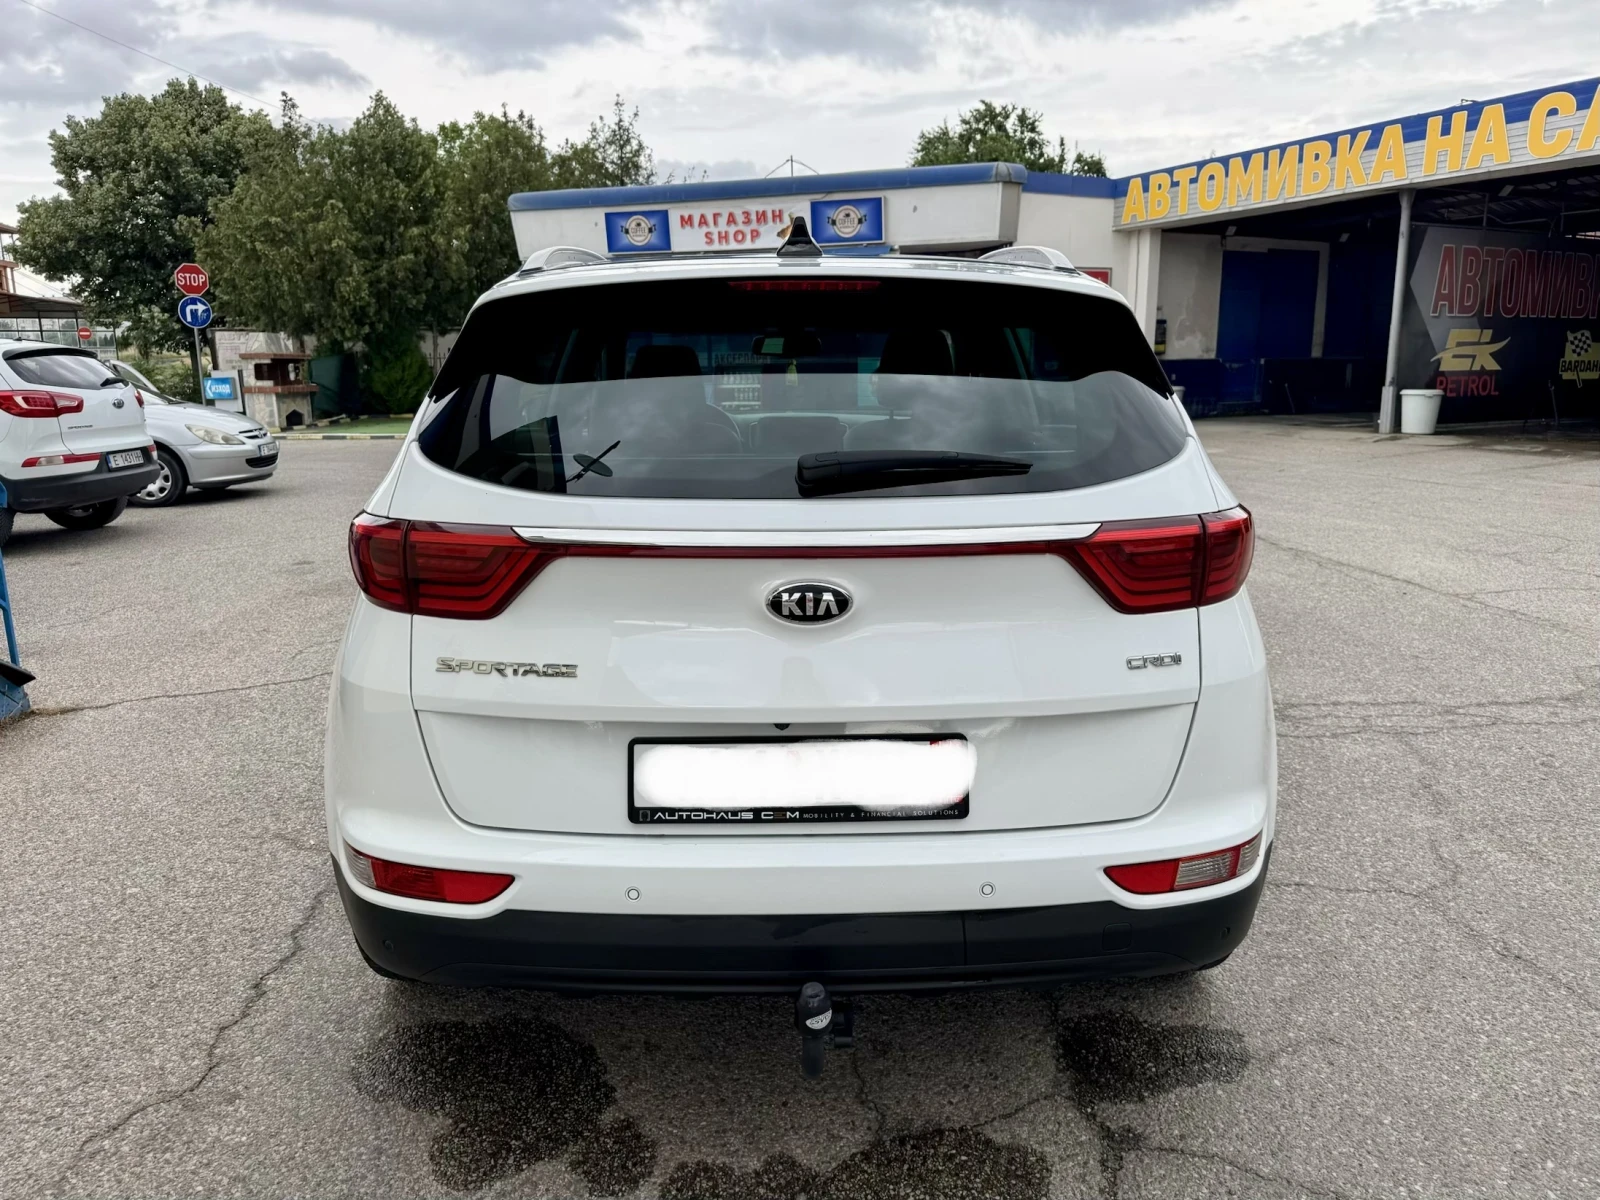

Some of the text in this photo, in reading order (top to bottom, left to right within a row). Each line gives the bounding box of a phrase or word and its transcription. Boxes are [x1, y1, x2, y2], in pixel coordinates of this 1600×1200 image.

[1121, 123, 1408, 225] АВТОМИВКА
[1422, 103, 1511, 177] НА
[679, 208, 783, 229] МАГАЗИН
[704, 228, 761, 247] SHOP
[177, 272, 206, 287] STOP
[1560, 359, 1600, 373] BARDAH
[211, 384, 231, 394] ИЗХОД
[1436, 375, 1500, 398] PETROL
[781, 592, 839, 616] KIA
[435, 656, 579, 678] SPORTAGE
[653, 811, 754, 820] AUTOHAUS
[861, 810, 907, 818] FINANCIAL
